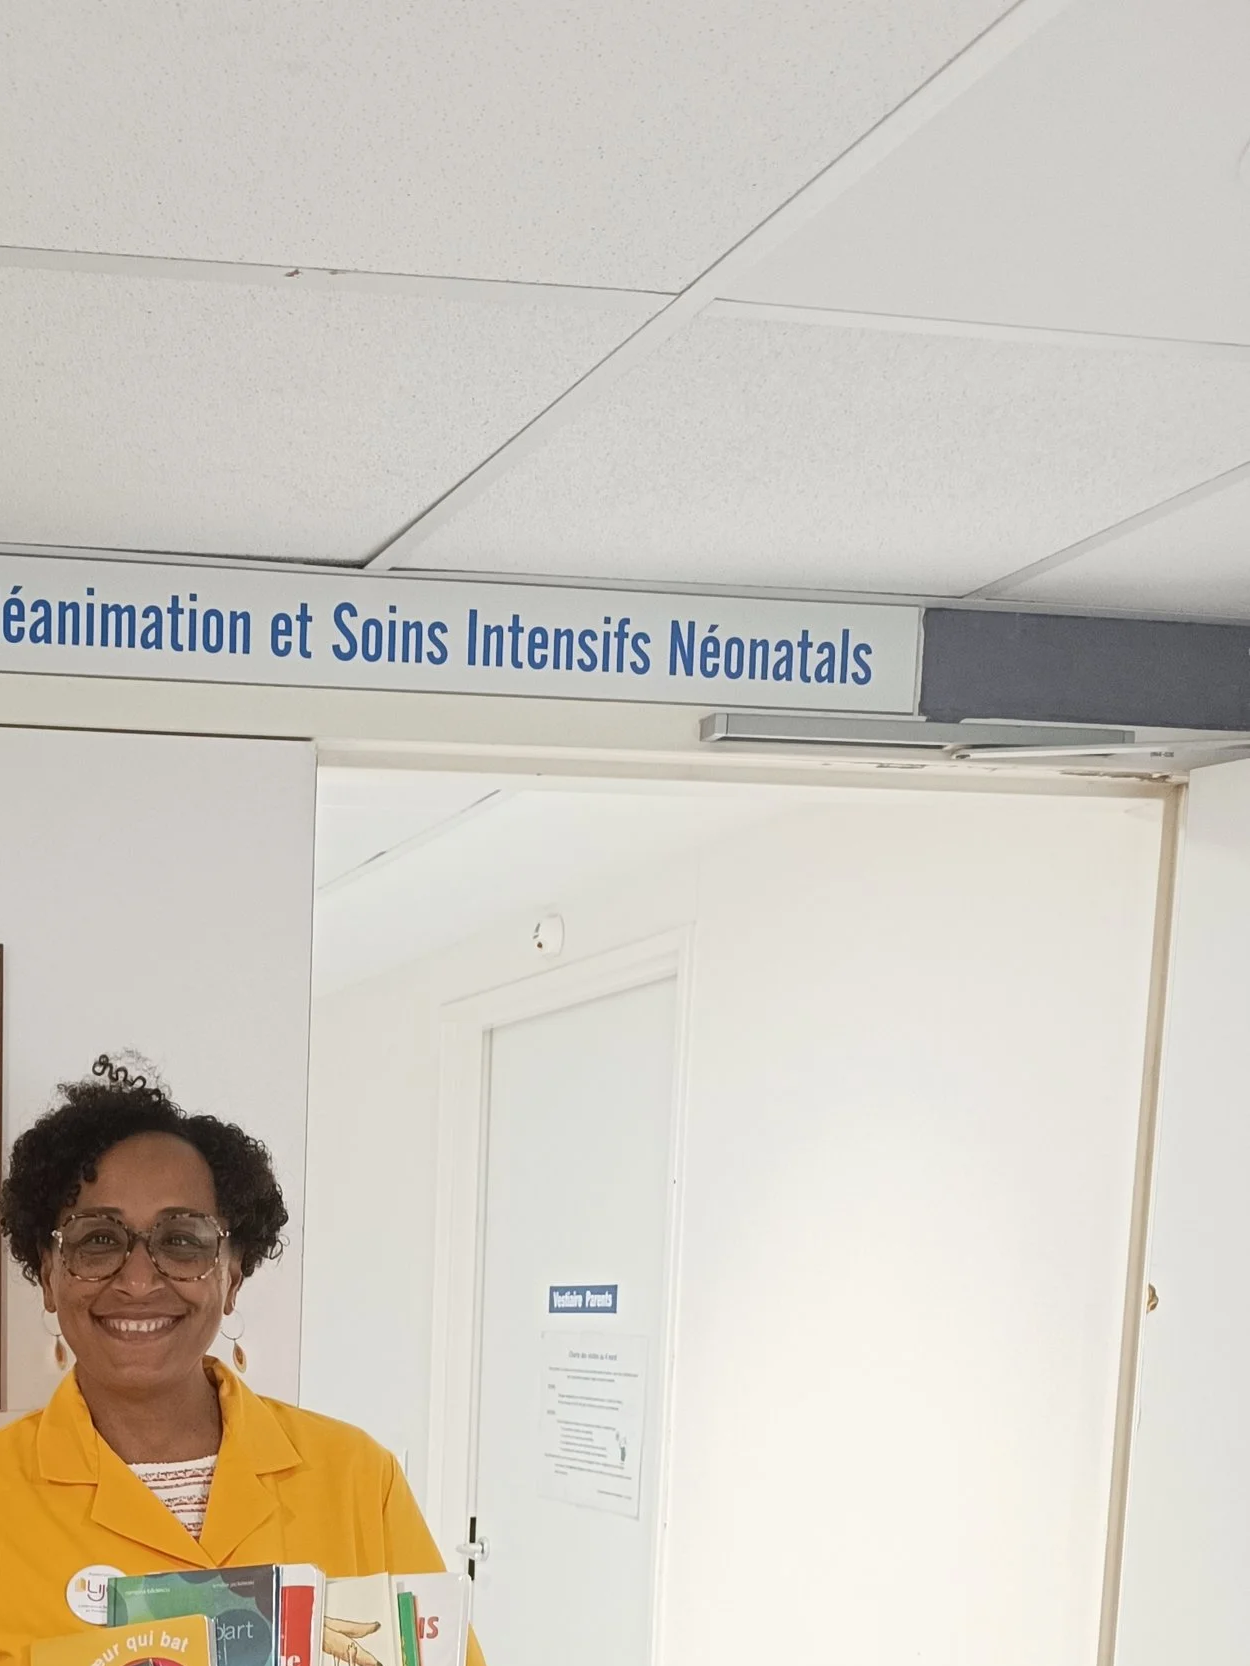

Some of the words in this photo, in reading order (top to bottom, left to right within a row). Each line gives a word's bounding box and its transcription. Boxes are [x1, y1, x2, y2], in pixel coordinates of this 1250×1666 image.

[270, 602, 312, 659] et
[332, 602, 448, 665] Soins
[467, 609, 651, 674] Intensifs
[669, 619, 872, 685] Néonatals
[585, 1290, 612, 1308] Parents
[126, 1630, 154, 1653] qui
[159, 1632, 189, 1653] bat
